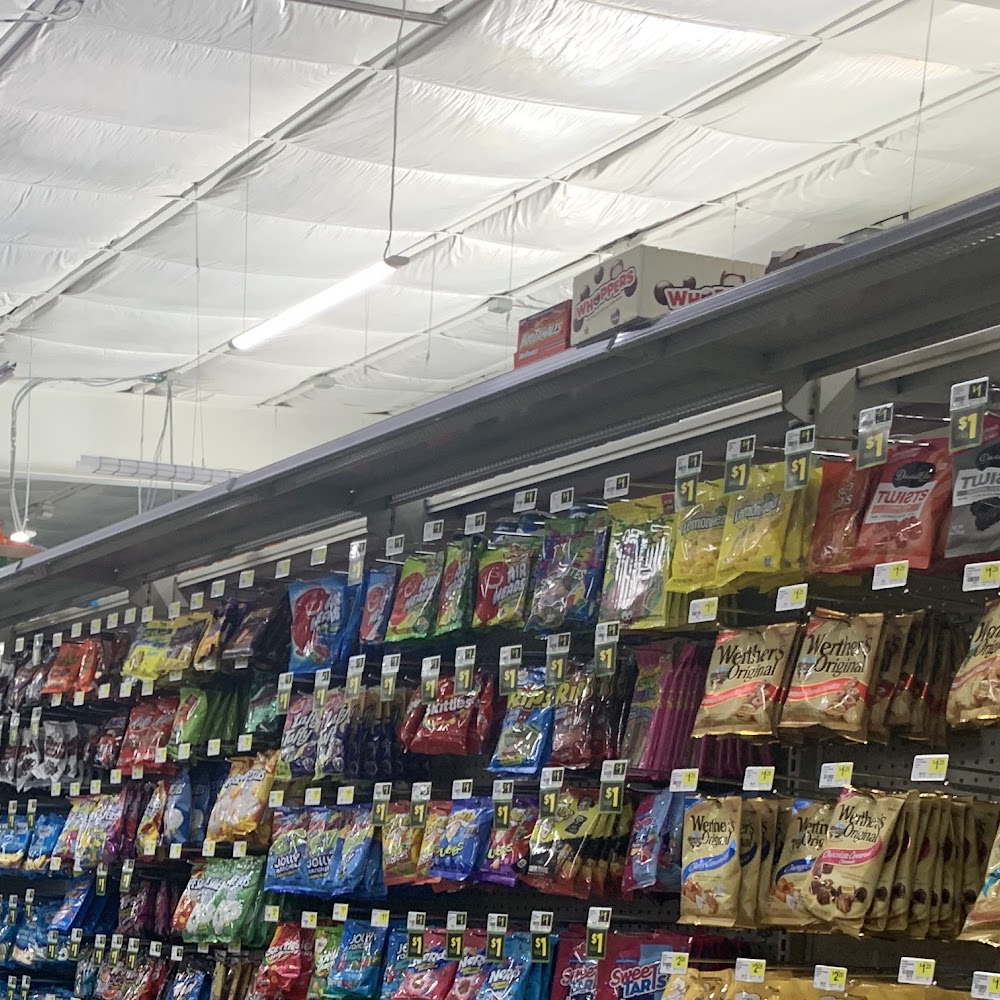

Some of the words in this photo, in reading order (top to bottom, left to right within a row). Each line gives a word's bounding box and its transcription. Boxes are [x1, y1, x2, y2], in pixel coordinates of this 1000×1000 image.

[958, 413, 977, 440] $1
[866, 433, 883, 457] $1
[732, 464, 745, 486] $1
[792, 457, 806, 480] $1
[681, 480, 693, 501] $1
[508, 563, 527, 584] AIR
[600, 648, 612, 668] $1
[814, 654, 865, 677] Original
[459, 669, 470, 688] $1
[504, 668, 516, 687] $1
[551, 660, 562, 678] $1
[728, 661, 778, 679] Original
[384, 679, 392, 695] $1
[425, 681, 435, 698] $1
[544, 794, 555, 811] $1
[606, 787, 619, 807] $1
[376, 804, 385, 821] $1
[415, 804, 424, 821] $1
[498, 805, 507, 823] $1
[844, 824, 880, 843] Original
[274, 852, 300, 868] JOLLY
[412, 936, 422, 954] $1
[451, 937, 461, 955] $1
[491, 938, 502, 956] $1
[536, 937, 546, 956] $1
[592, 933, 603, 953] $1
